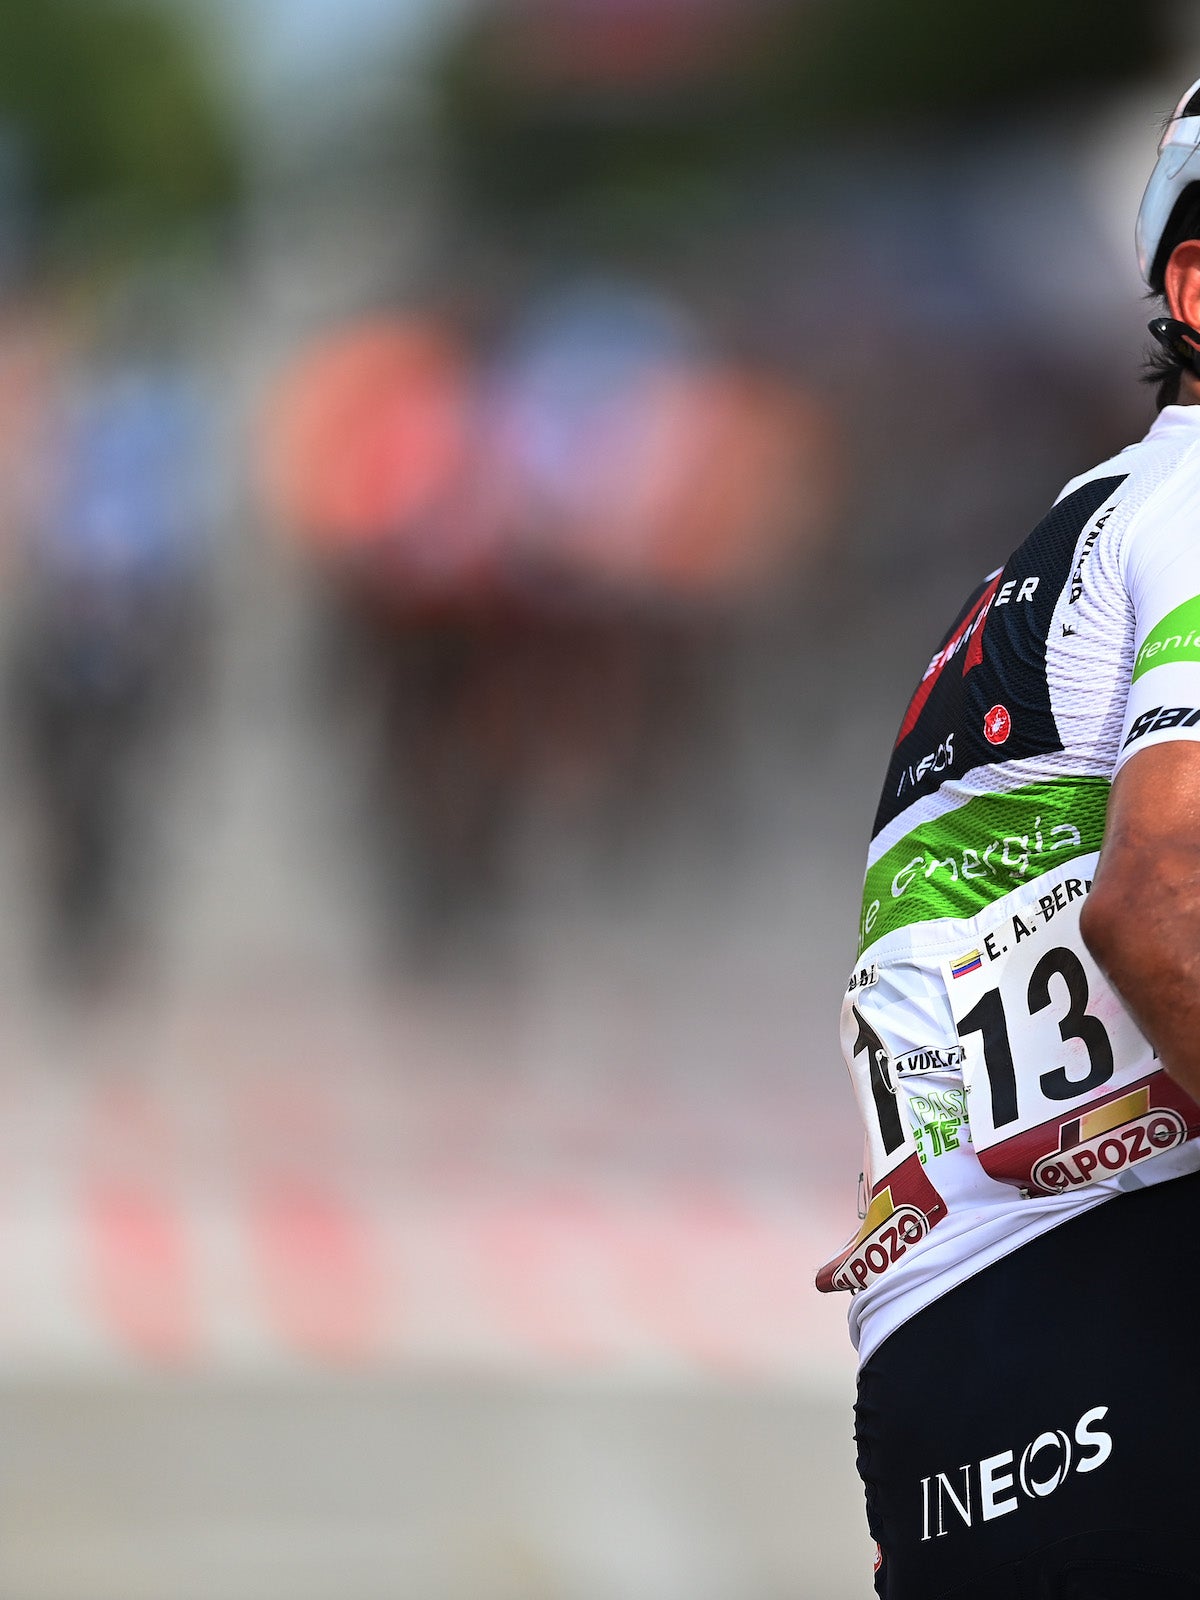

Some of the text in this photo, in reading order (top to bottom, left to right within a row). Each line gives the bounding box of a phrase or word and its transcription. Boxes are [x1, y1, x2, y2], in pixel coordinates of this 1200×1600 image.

[983, 932, 1008, 961] E.
[1012, 914, 1037, 944] A.
[956, 946, 1159, 1131] 13
[910, 1088, 968, 1125] PAS
[920, 1405, 1113, 1542] INEOS
